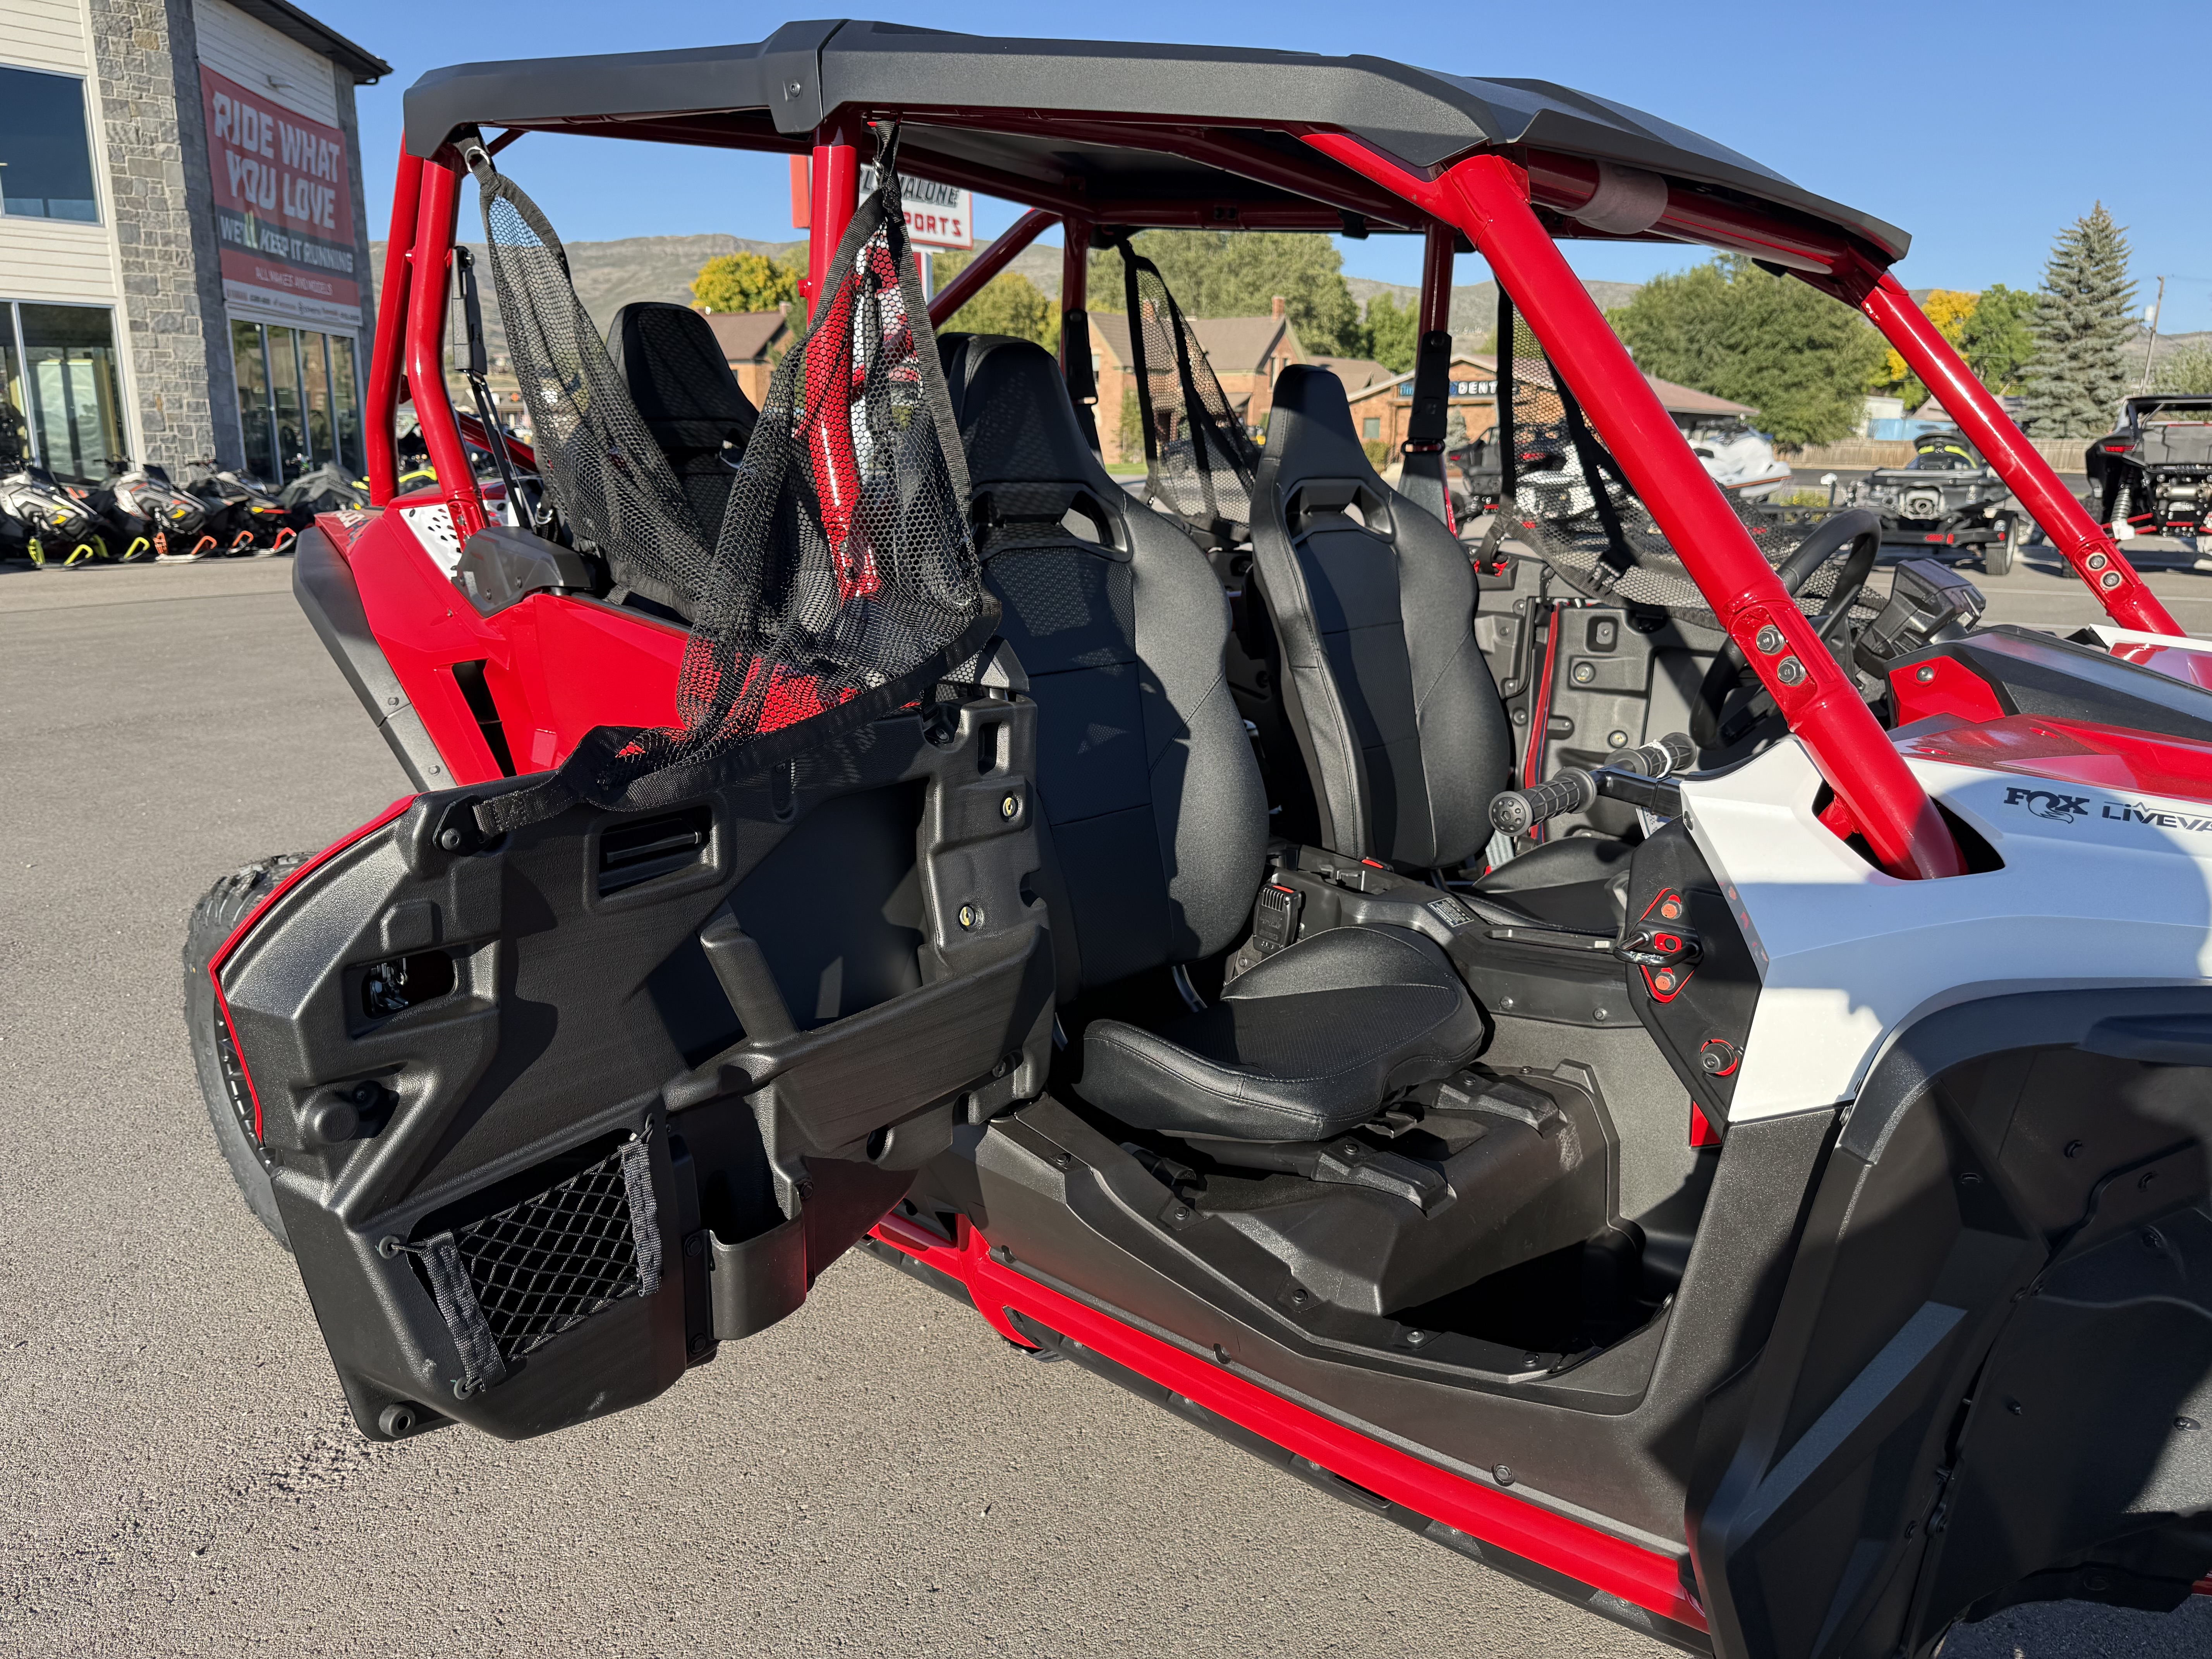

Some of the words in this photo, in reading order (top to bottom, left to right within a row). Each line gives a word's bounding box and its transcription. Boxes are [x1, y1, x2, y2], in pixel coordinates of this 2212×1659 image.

[213, 91, 274, 159] RIDE
[277, 120, 340, 183] WHAT
[225, 149, 276, 210] YOU
[283, 173, 336, 229] LOVE
[903, 211, 962, 237] PORTS
[220, 215, 259, 249] WE'LL
[259, 228, 289, 258] KEEP
[290, 237, 303, 261] IT
[303, 241, 354, 273] RUNNING
[255, 266, 271, 282] ALL
[1458, 380, 1498, 395] DENT
[2004, 787, 2090, 820] FOX
